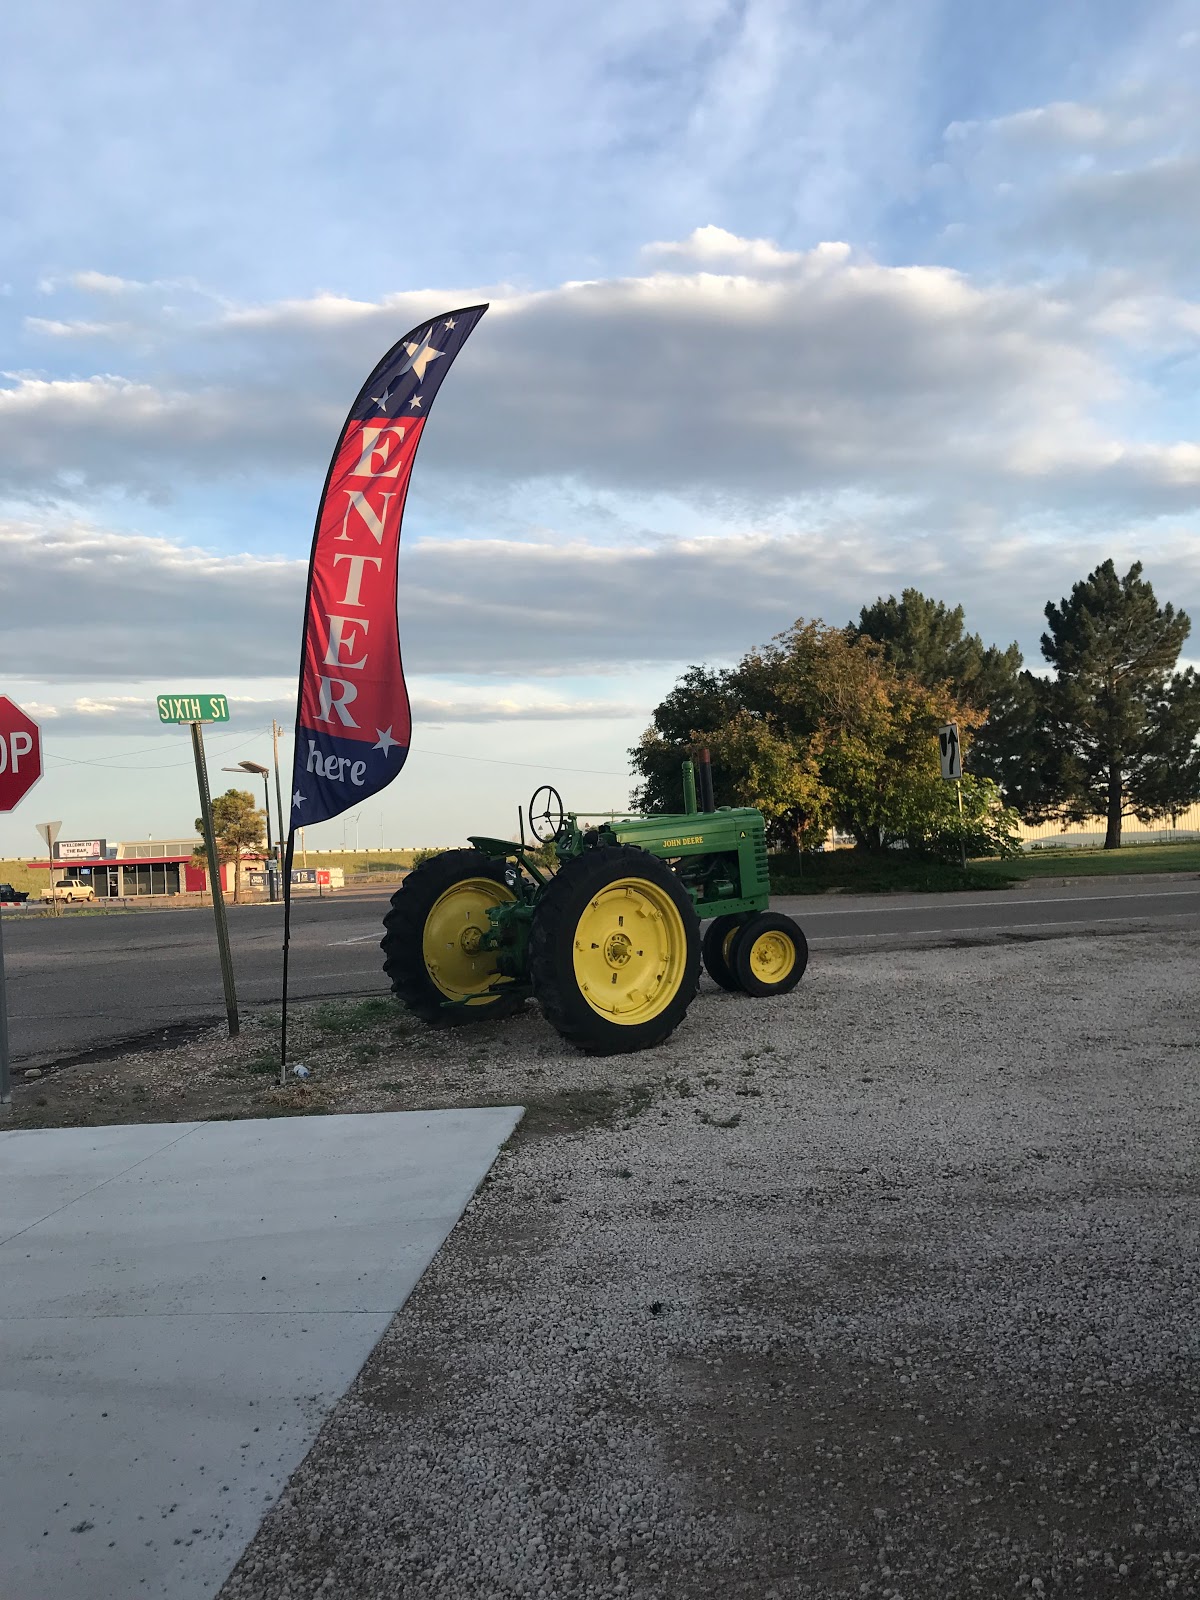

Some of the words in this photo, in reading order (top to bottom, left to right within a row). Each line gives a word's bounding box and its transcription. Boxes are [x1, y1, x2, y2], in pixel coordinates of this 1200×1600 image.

[313, 426, 406, 729] ENTER
[158, 698, 202, 719] SIXTH
[209, 697, 226, 718] ST
[306, 739, 367, 786] here
[662, 839, 682, 848] JOHN
[682, 836, 704, 845] DEERE
